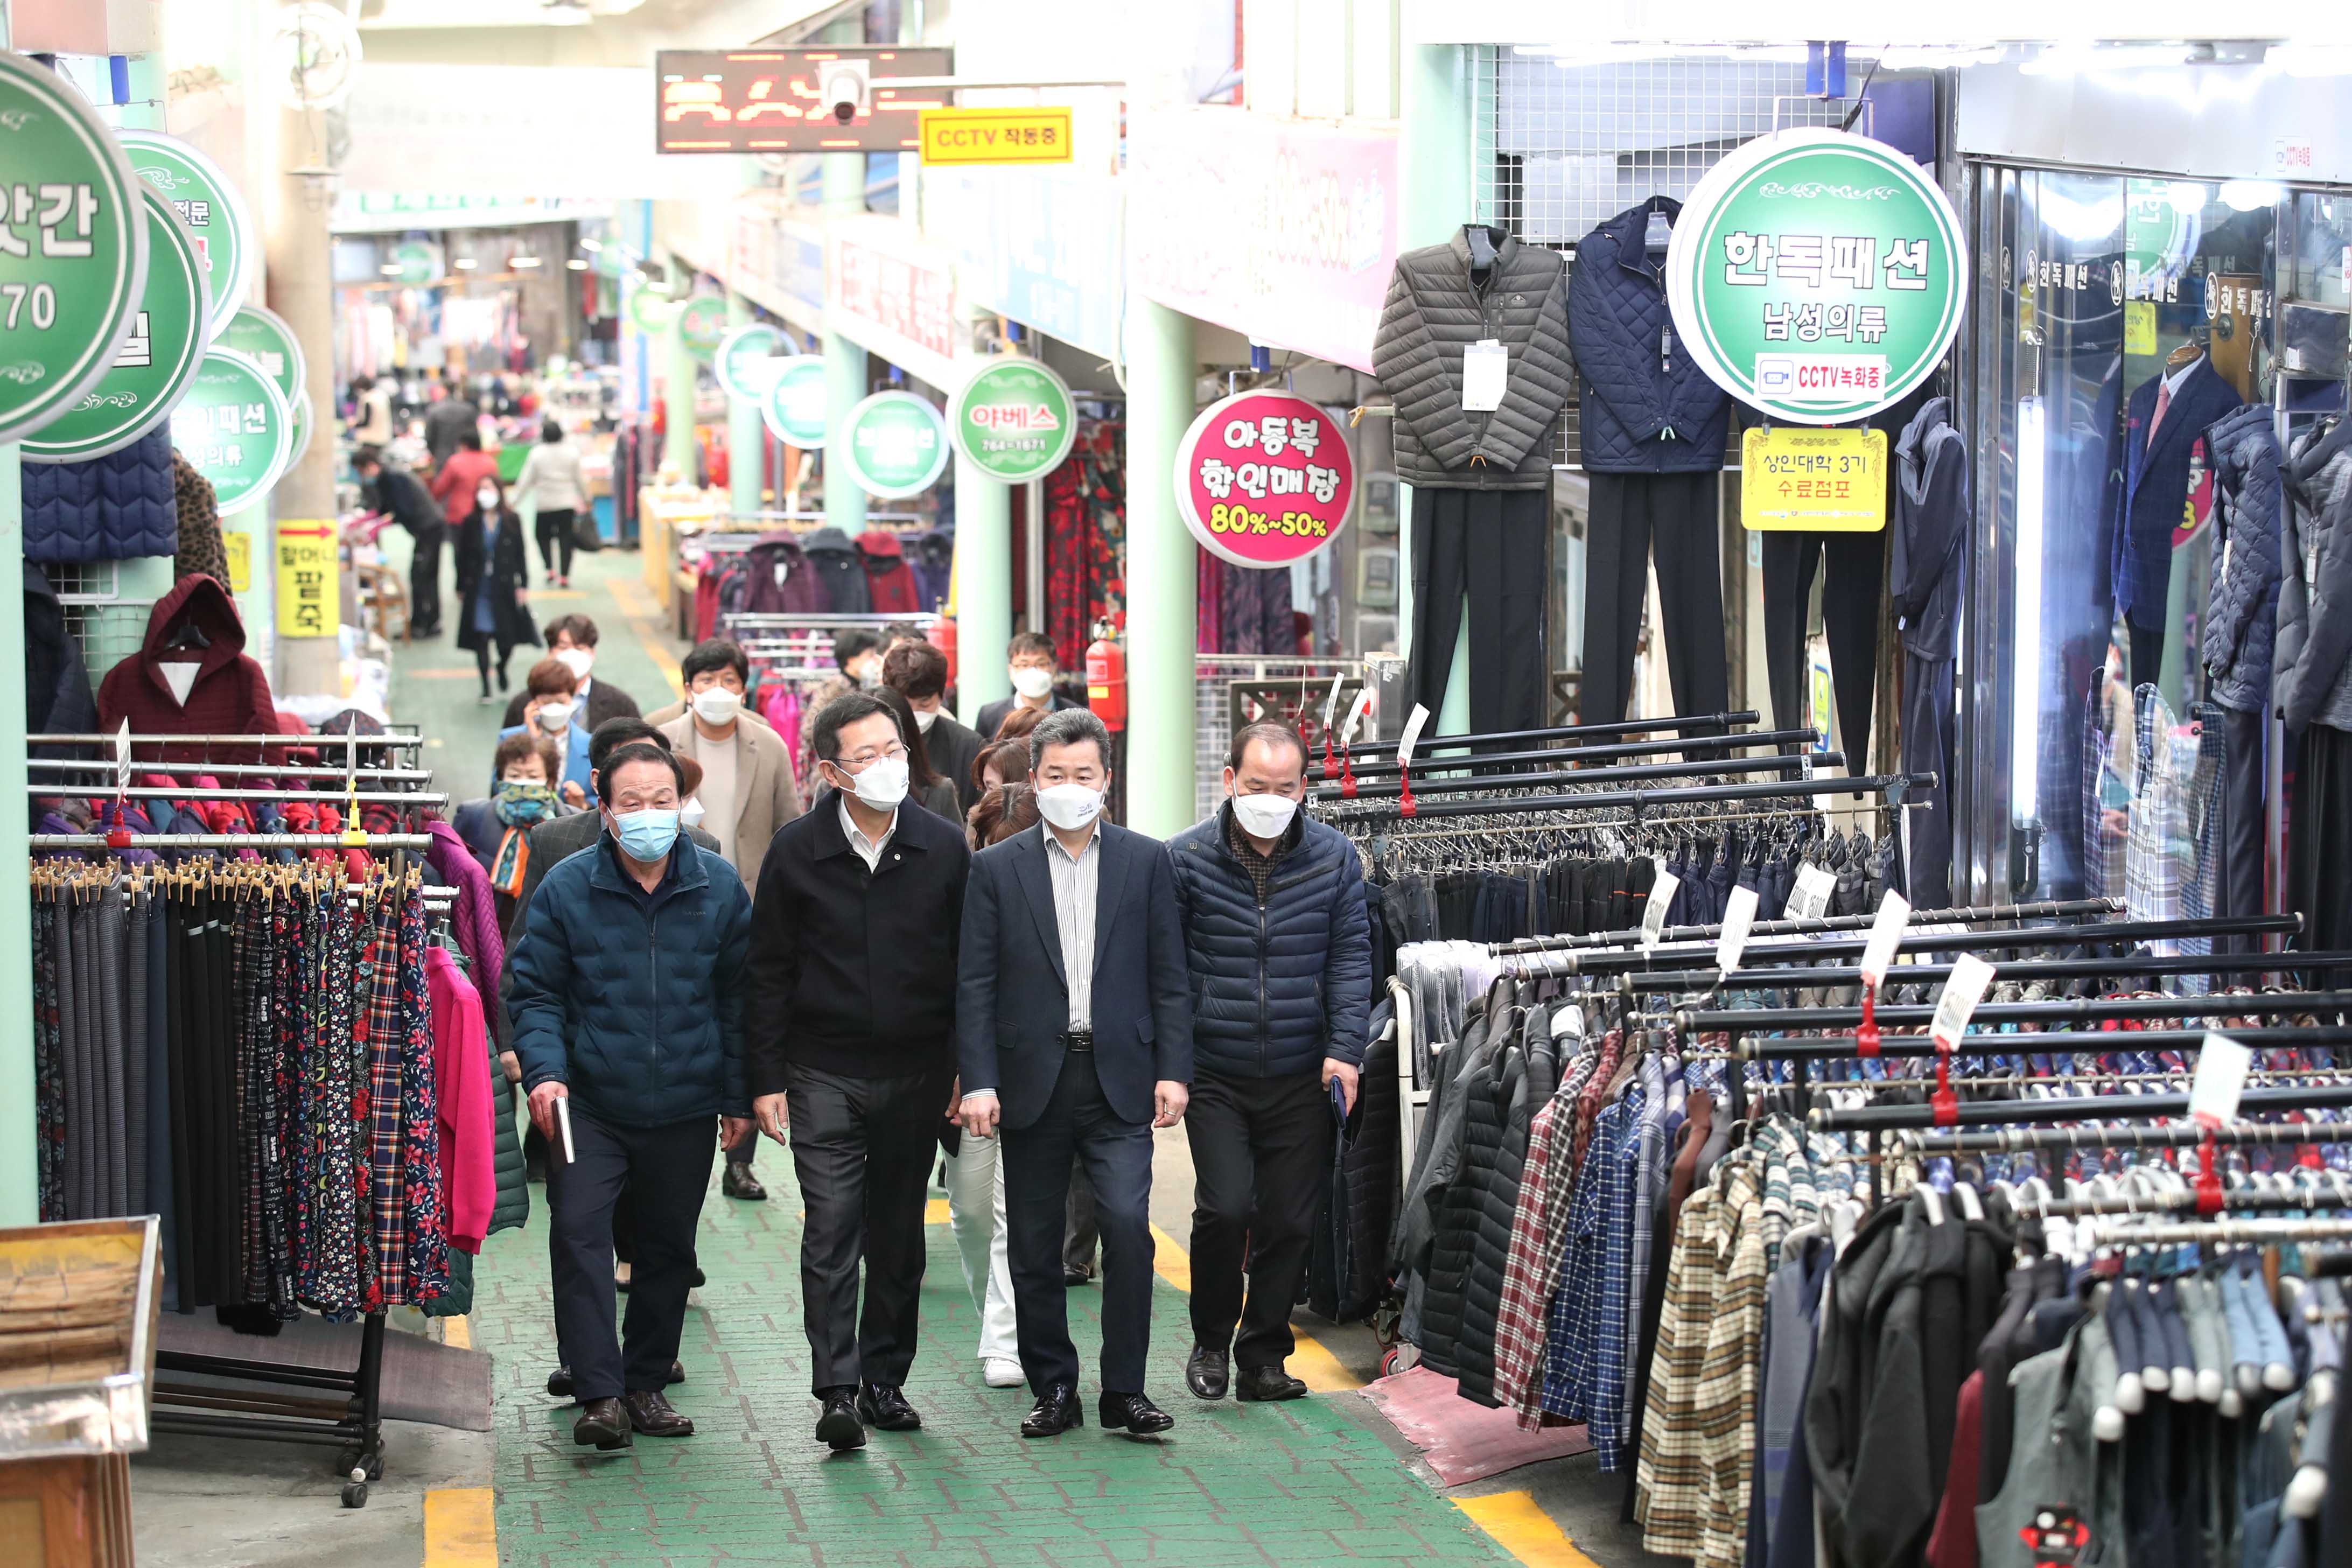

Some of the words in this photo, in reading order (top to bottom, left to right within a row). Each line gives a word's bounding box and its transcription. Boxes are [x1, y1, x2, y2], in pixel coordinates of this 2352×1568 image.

[937, 129, 998, 147] CCTV
[1004, 127, 1057, 146] 작동중
[1724, 231, 1930, 291] 한독패션
[2039, 261, 2088, 290] 한독패션
[1763, 302, 1887, 344] 남성의류
[1799, 366, 1879, 388] CCTV녹화중
[971, 405, 1060, 430] 야베스
[1223, 416, 1320, 458] 아동복
[1763, 456, 1832, 473] 상인대학
[1839, 456, 1866, 474] 3기
[1199, 458, 1340, 504] 할인매장
[1778, 480, 1850, 498] 수료점포
[1209, 502, 1327, 537] 80%~50%
